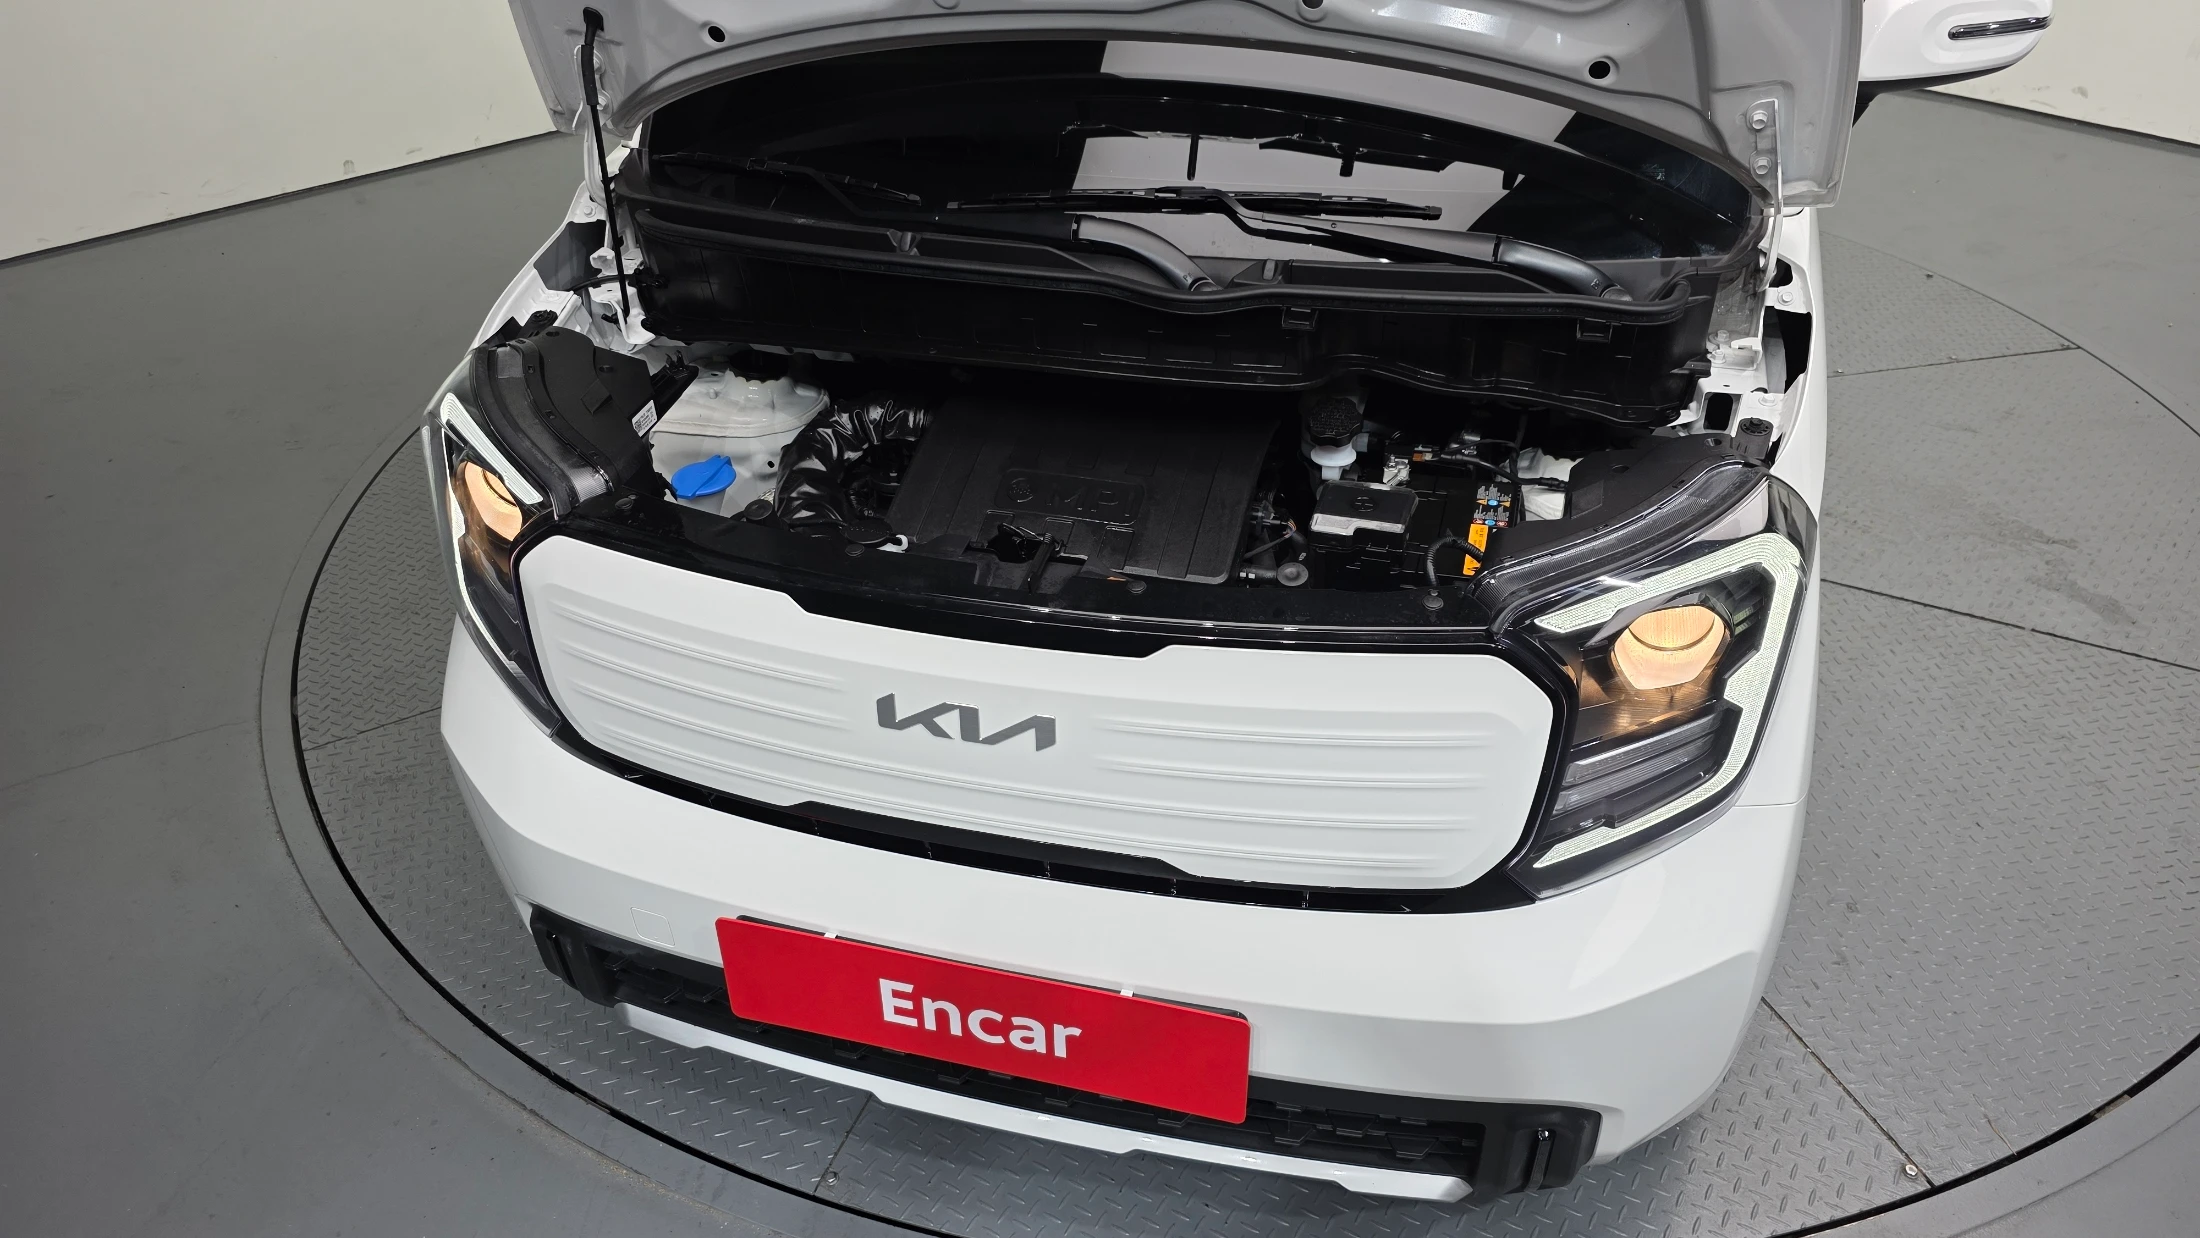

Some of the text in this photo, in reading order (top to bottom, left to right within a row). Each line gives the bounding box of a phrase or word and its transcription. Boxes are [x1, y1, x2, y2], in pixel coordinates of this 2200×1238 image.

[1045, 482, 1136, 517] MPI
[877, 692, 1056, 752] KIA
[879, 978, 1082, 1059] Encar
